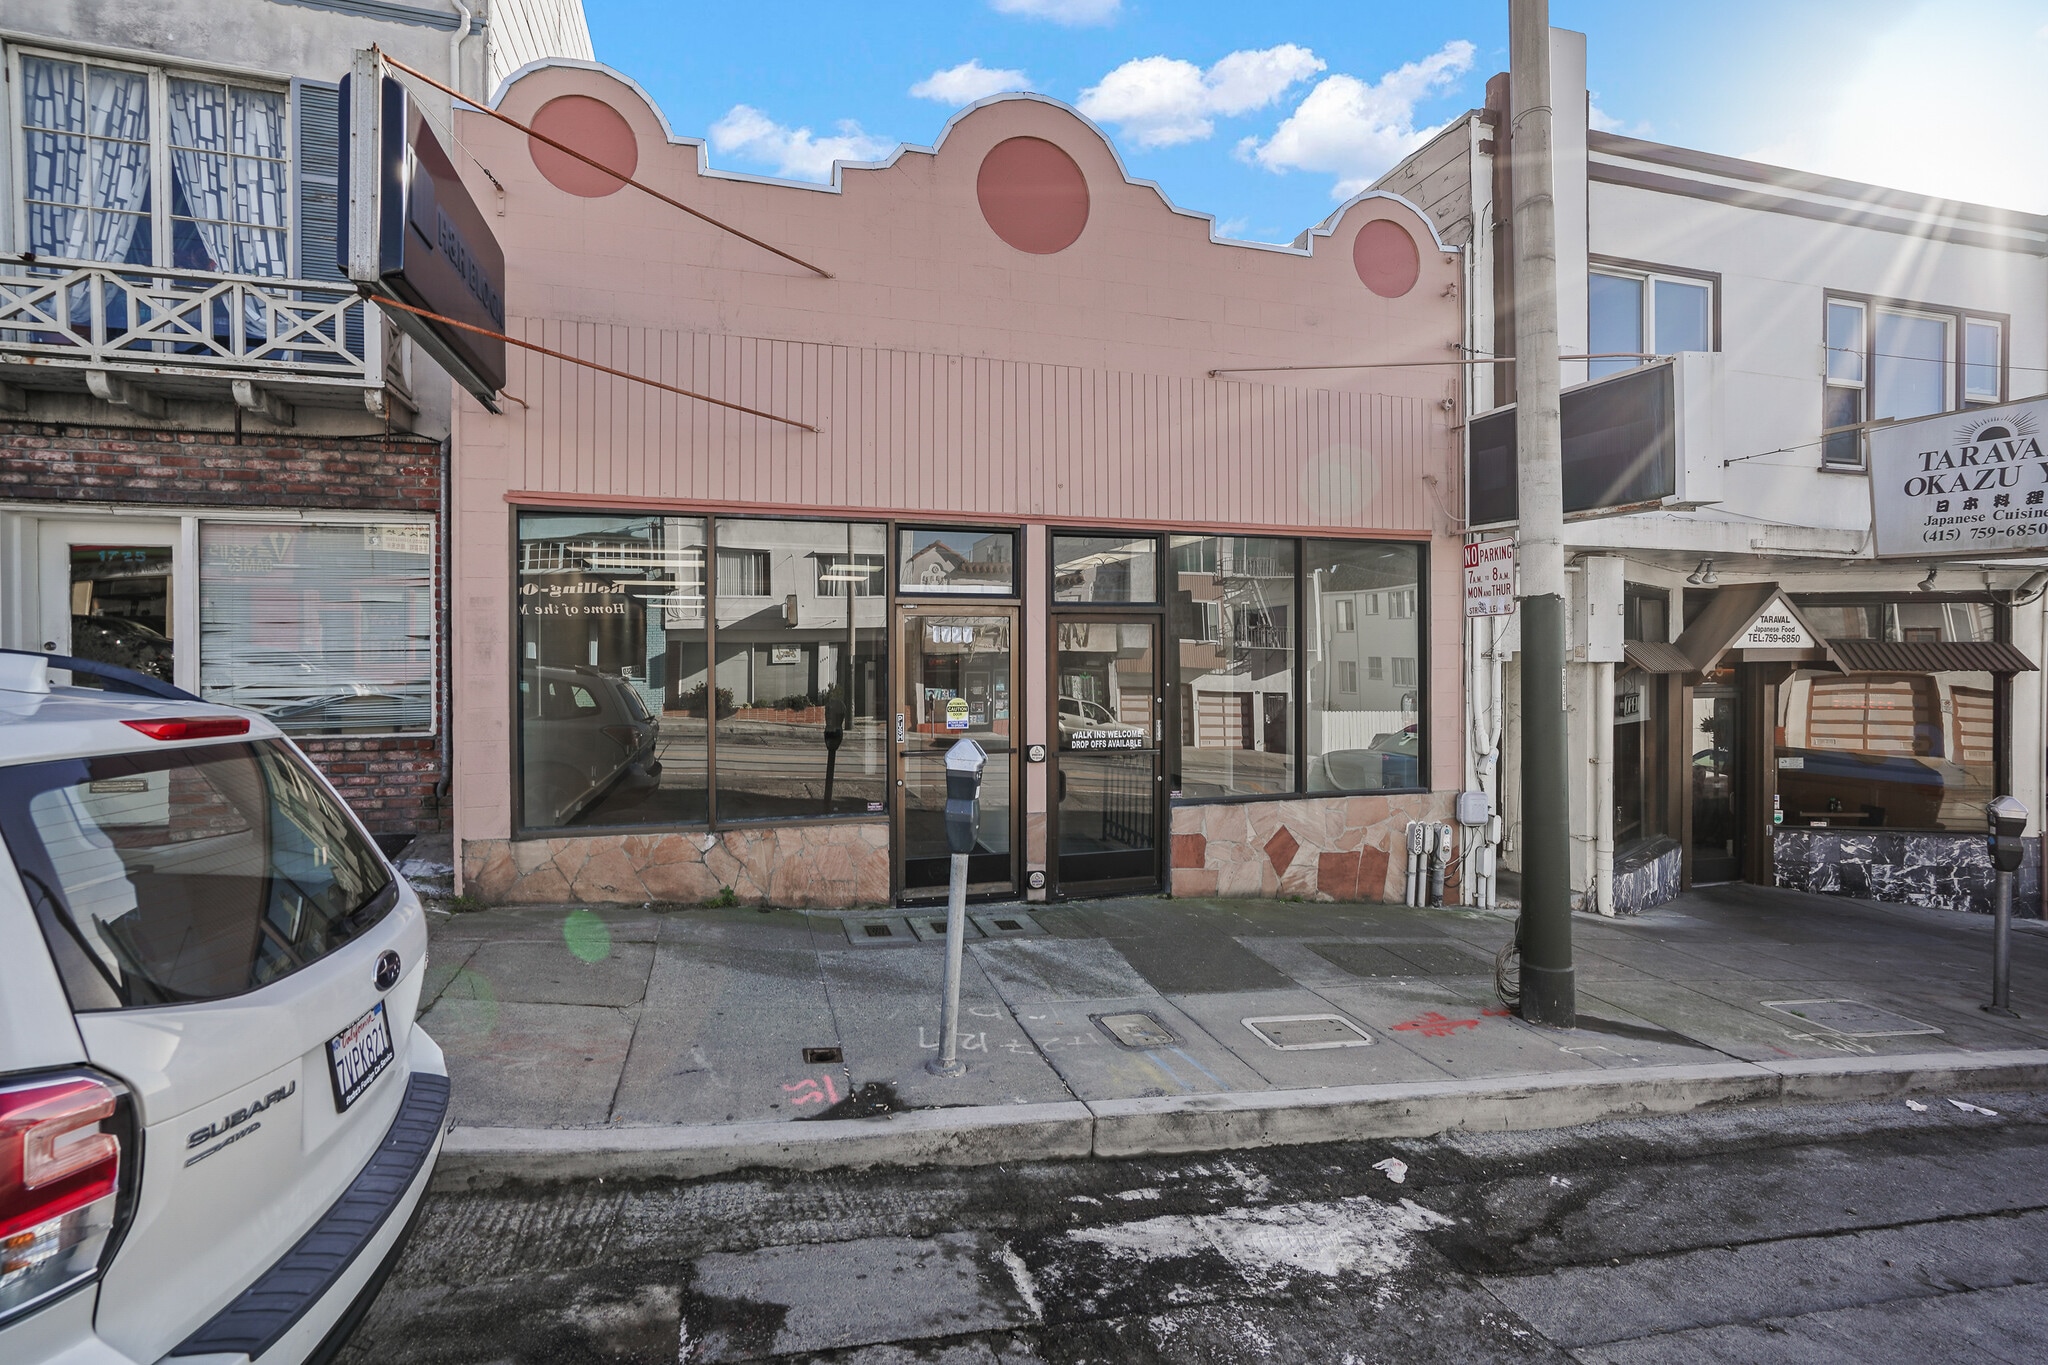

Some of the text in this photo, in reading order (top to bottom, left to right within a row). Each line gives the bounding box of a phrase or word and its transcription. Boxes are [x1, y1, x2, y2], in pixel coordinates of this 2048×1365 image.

[1918, 437, 2048, 472] TARAVA
[1904, 465, 2023, 497] OKAZU
[1936, 490, 2045, 513] 日本料理
[1923, 508, 2048, 528] Japanese Cuisine
[1923, 522, 2048, 543] (415) 759-6850
[98, 550, 147, 562] 1725
[1464, 545, 1512, 566] NO PARKING
[1468, 586, 1483, 598] MON
[1492, 583, 1511, 597] THUR
[1754, 625, 1796, 633] Japanese Food
[1760, 615, 1791, 623] TARAVAL
[933, 626, 972, 643] 1727
[1748, 633, 1801, 643] TEL:759-6850
[896, 714, 904, 742] PUSH
[1072, 730, 1142, 739] WALK INS WELCOME
[1071, 739, 1142, 749] DROP OFFS AVAILABLE
[336, 1022, 388, 1095] 7VPK821
[186, 1080, 296, 1149] SUBARU
